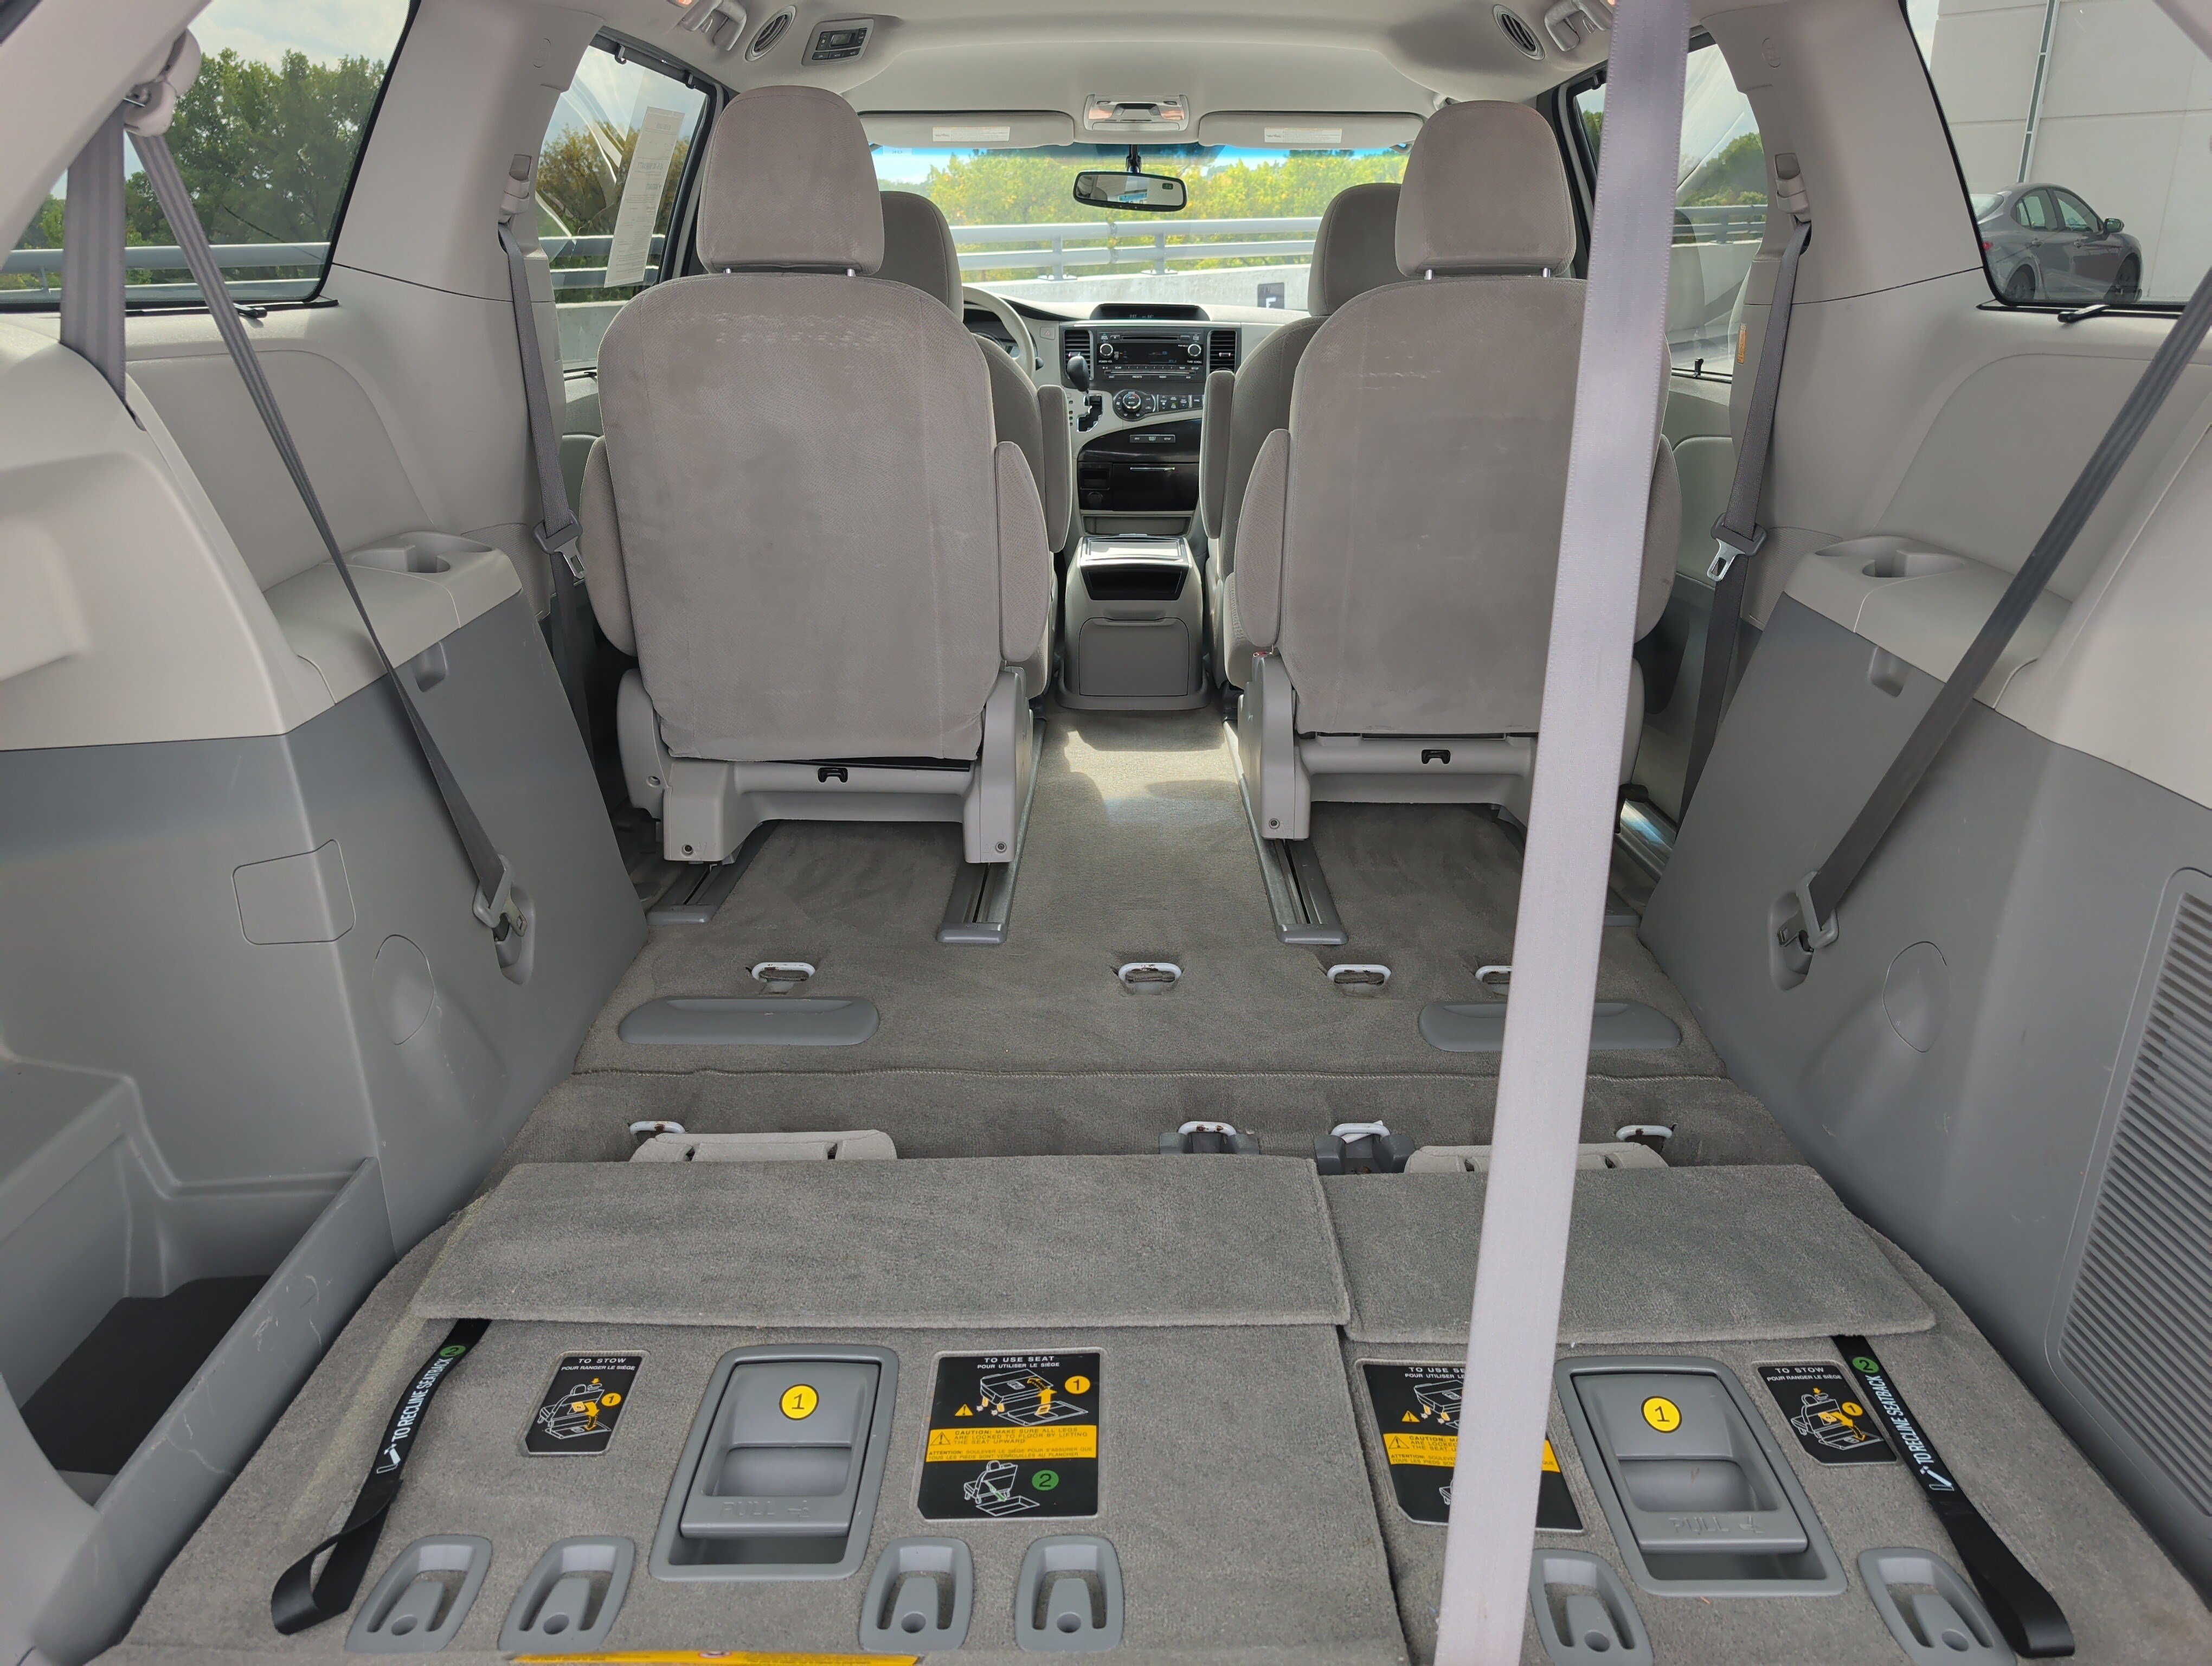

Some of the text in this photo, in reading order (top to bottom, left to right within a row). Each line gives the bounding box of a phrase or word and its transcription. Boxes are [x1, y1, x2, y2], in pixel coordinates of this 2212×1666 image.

[445, 1347, 459, 1355] 2
[1859, 1360, 1874, 1371] 2
[391, 1357, 454, 1443] TO RECLINE SEATBACK
[792, 1393, 805, 1409] 1
[1655, 1406, 1670, 1422] 1
[1865, 1375, 1934, 1464] TO RECLINE SEATBACK
[1039, 1473, 1052, 1487] 2
[719, 1500, 775, 1517] PULL
[1668, 1516, 1729, 1533] PULL
